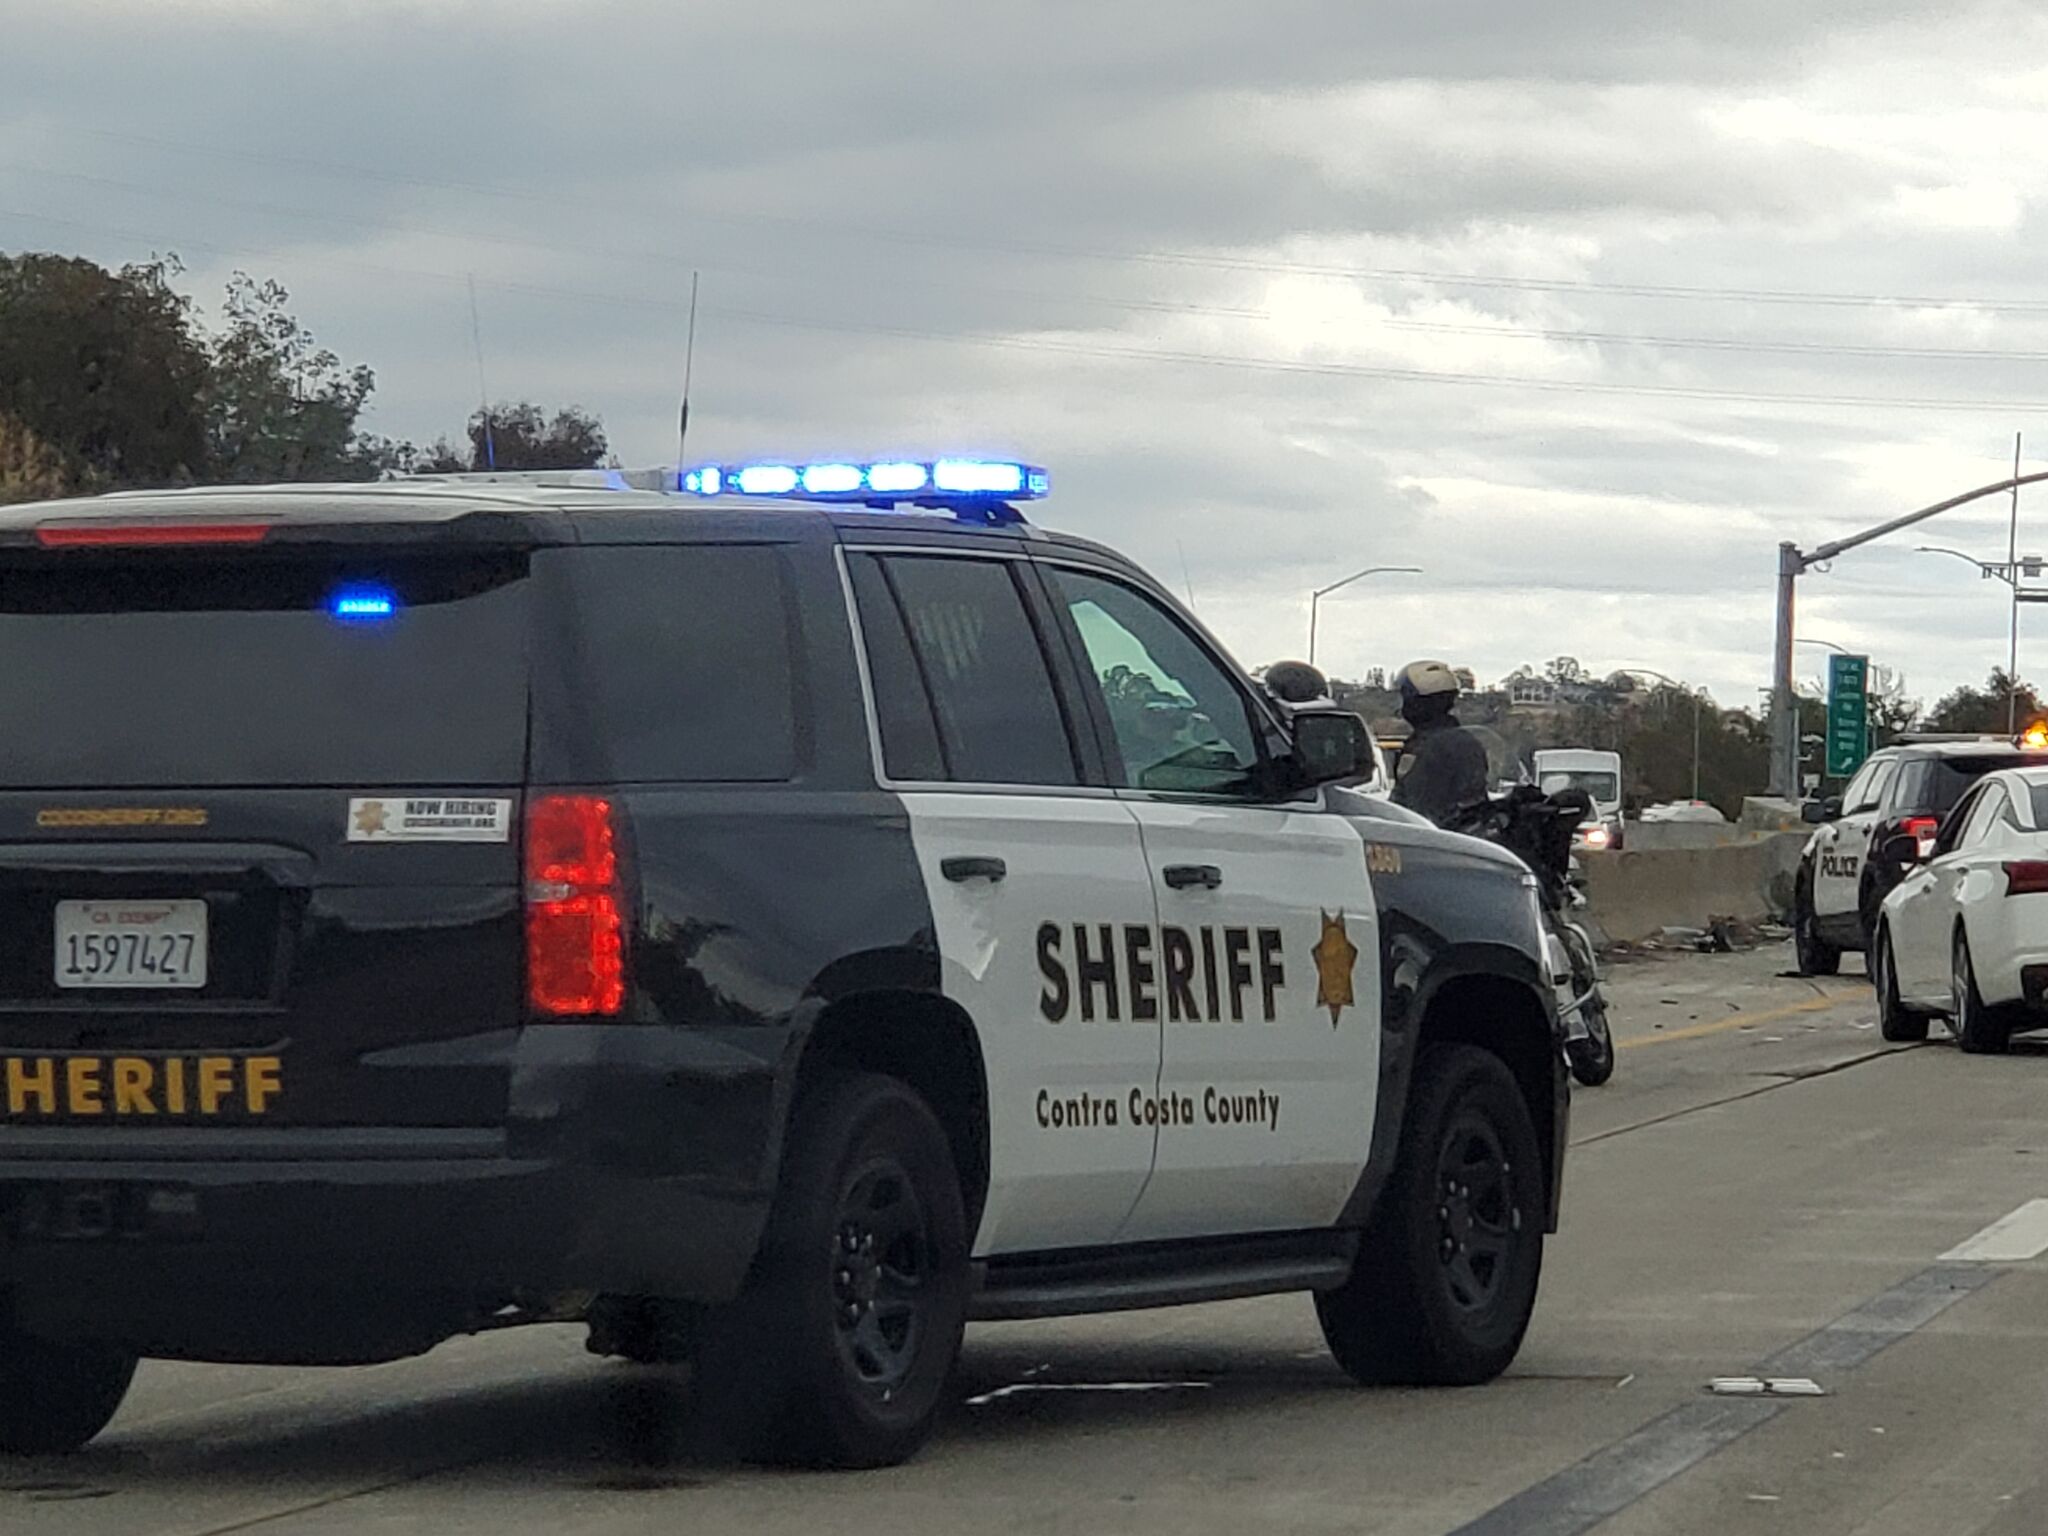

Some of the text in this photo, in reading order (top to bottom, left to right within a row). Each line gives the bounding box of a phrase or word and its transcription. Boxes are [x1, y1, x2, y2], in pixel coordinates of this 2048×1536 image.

[405, 800, 498, 816] NOW HIRING
[1820, 855, 1859, 878] POLICE
[66, 933, 195, 975] 1597427
[1036, 919, 1286, 1024] SHERIFF
[1036, 1086, 1281, 1132] Contra Costa County
